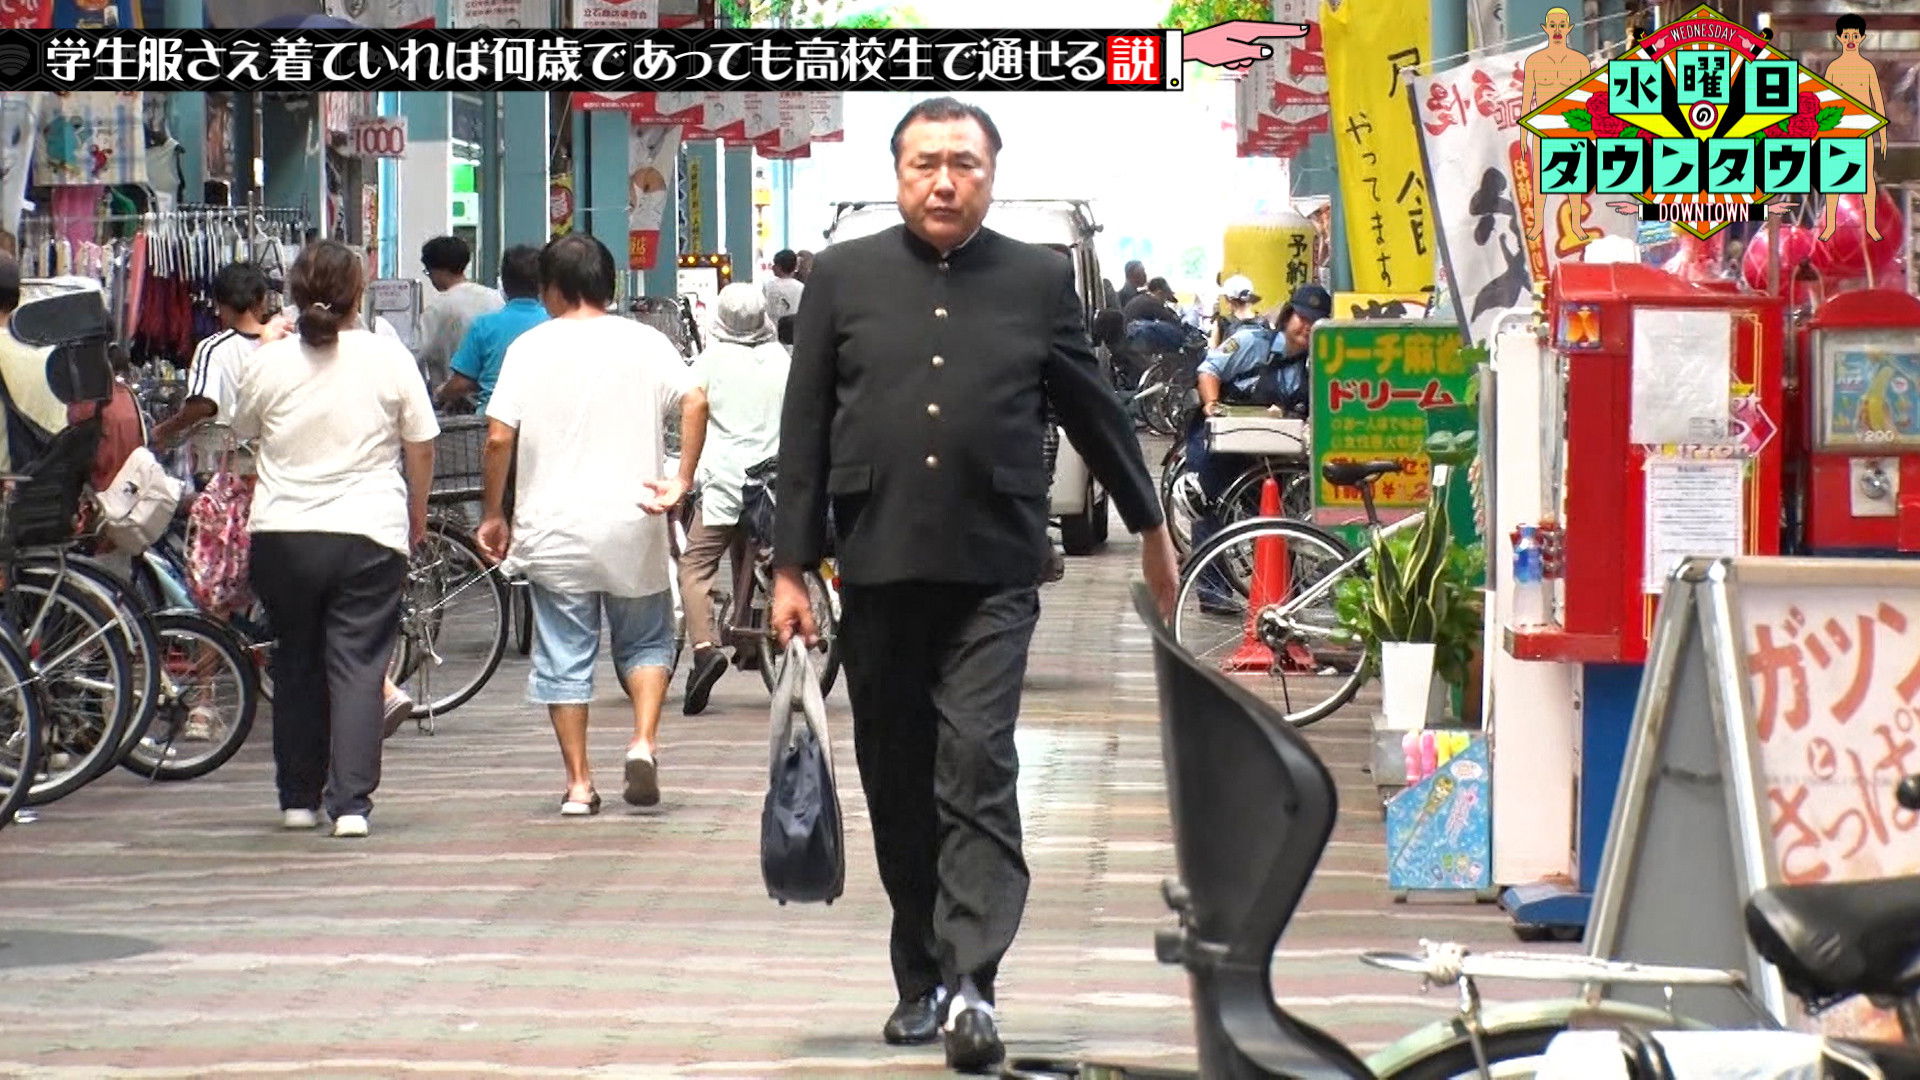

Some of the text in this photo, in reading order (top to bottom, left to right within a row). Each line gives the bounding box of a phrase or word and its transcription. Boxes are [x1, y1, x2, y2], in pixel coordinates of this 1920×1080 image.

[1346, 112, 1392, 288] やってます
[1287, 234, 1308, 296] 予約
[1330, 380, 1454, 411] ドリーム
[1768, 706, 1920, 885] さっぱ
